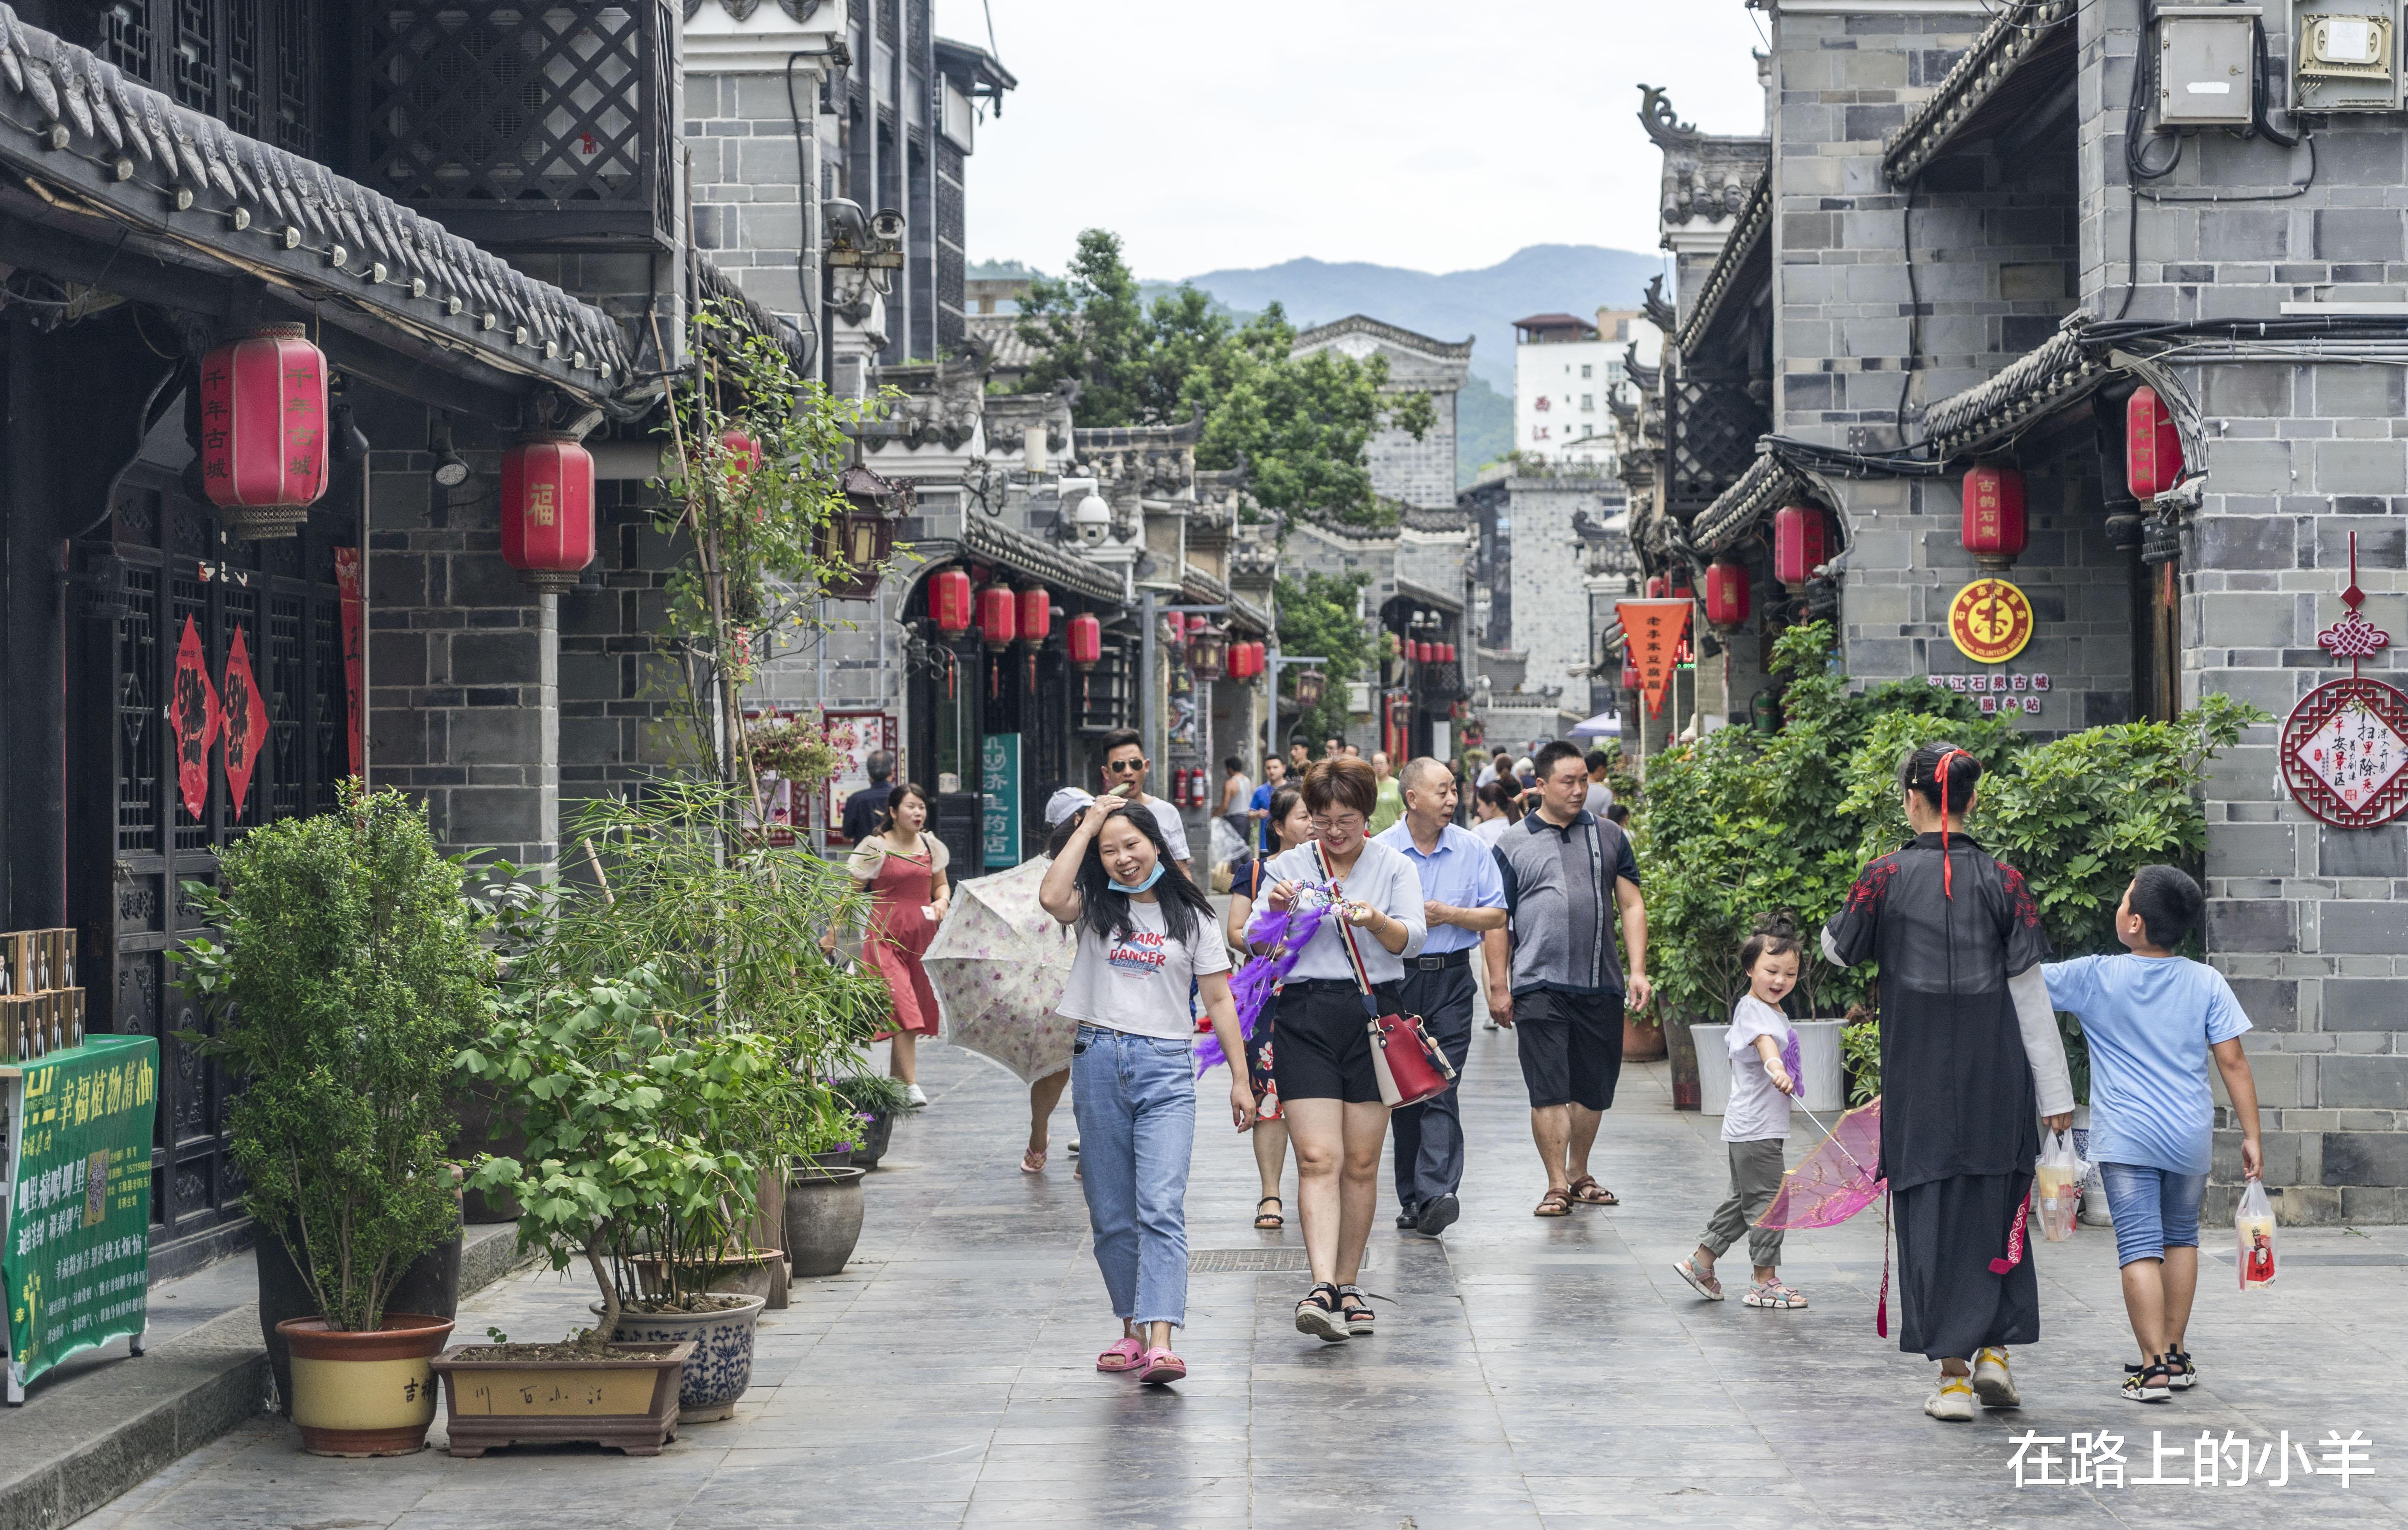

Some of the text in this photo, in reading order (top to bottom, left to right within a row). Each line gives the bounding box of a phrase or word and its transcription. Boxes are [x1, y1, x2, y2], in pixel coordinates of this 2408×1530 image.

[204, 370, 228, 479] 千年古城
[285, 367, 318, 476] 千年古城
[2133, 407, 2152, 481] 千年古城
[527, 482, 554, 527] 福
[1978, 480, 1996, 537] 古韵石泉
[1954, 585, 2027, 622] 石泉志愿服务
[1975, 646, 2009, 657] VOLUNTEER
[2008, 627, 2026, 650] SERVICE
[1930, 675, 2048, 691] 汉江石泉古城
[2332, 716, 2348, 786] 平安景区
[2357, 723, 2379, 794] 扫黑除恶
[2377, 728, 2391, 774] 深入开展
[58, 1057, 153, 1131] 幸福植物精油
[19, 1157, 86, 1218] 哪里痛喷哪里
[48, 1205, 82, 1241] 调养理气
